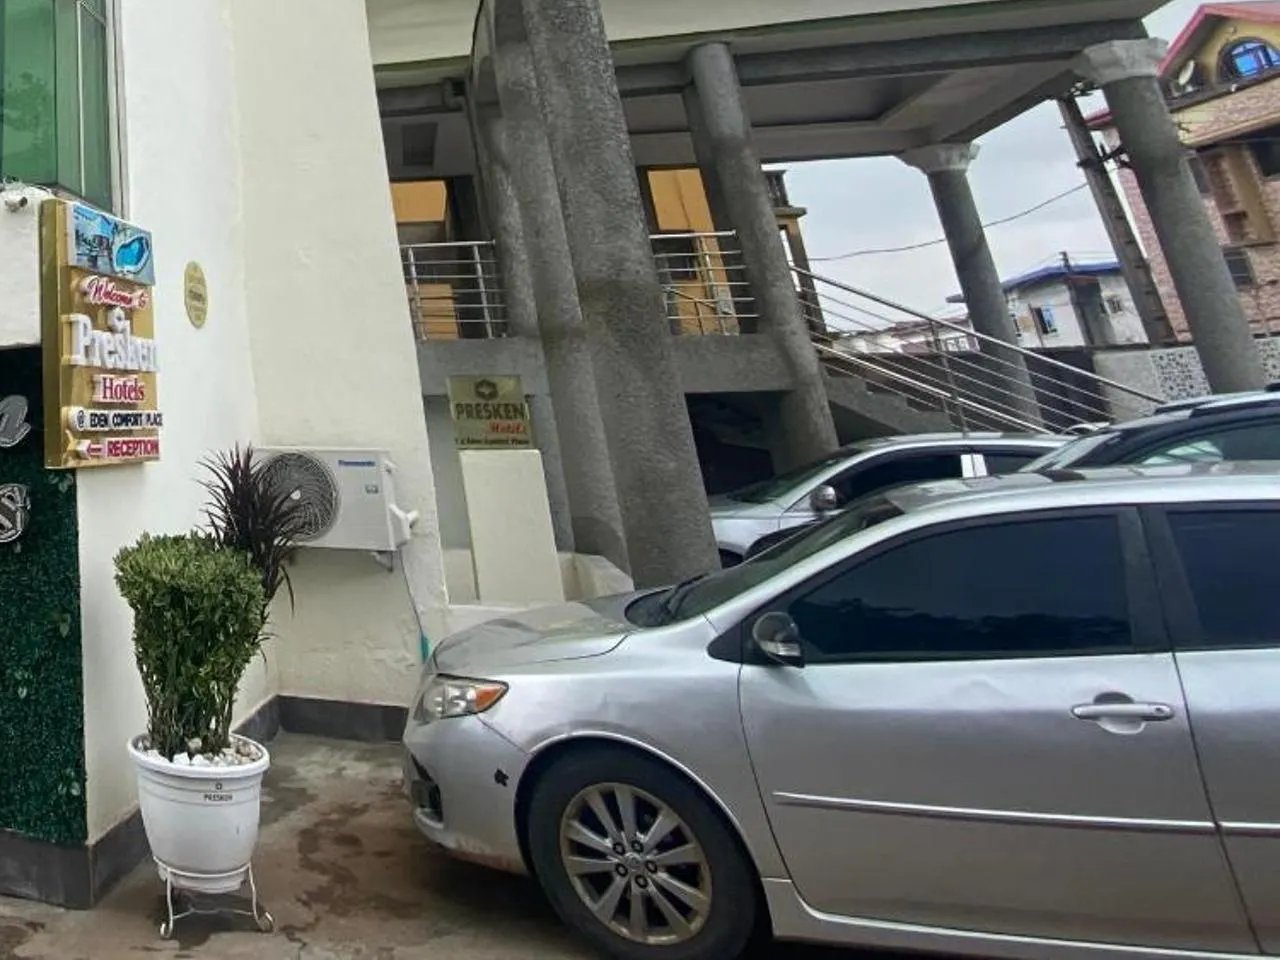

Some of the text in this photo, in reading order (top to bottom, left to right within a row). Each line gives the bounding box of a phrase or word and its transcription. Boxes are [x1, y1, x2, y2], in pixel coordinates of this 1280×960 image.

[70, 313, 159, 372] Presken
[102, 376, 145, 401] Hotels
[89, 413, 109, 428] EDEN
[112, 412, 143, 428] COMFORT
[456, 403, 525, 420] PRESKEN
[106, 440, 160, 458] RECEPTION
